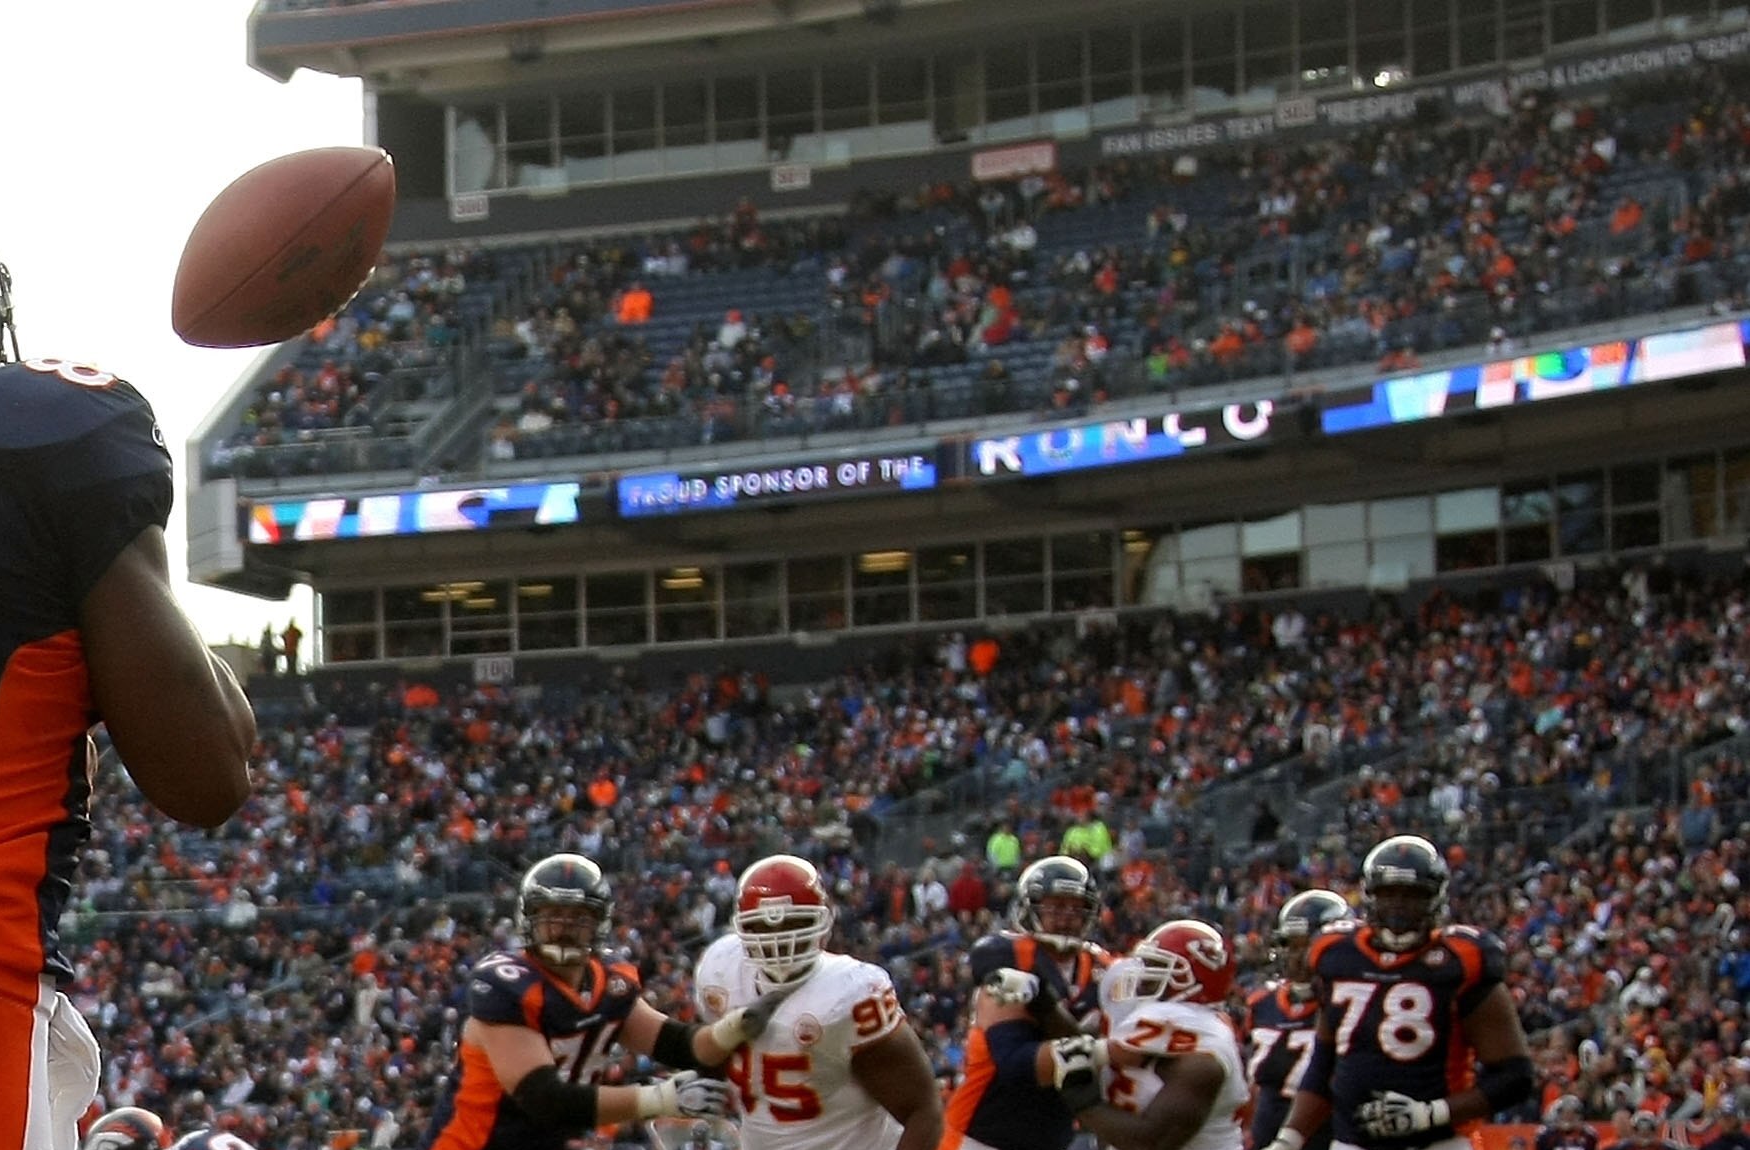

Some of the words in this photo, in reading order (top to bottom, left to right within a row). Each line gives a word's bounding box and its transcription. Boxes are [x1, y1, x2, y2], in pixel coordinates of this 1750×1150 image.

[1147, 121, 1217, 149] ISSUES
[714, 465, 830, 500] SPONSOR
[837, 461, 870, 487] OF
[878, 454, 924, 482] THE
[1331, 981, 1436, 1062] 78
[1247, 1027, 1317, 1097] 77
